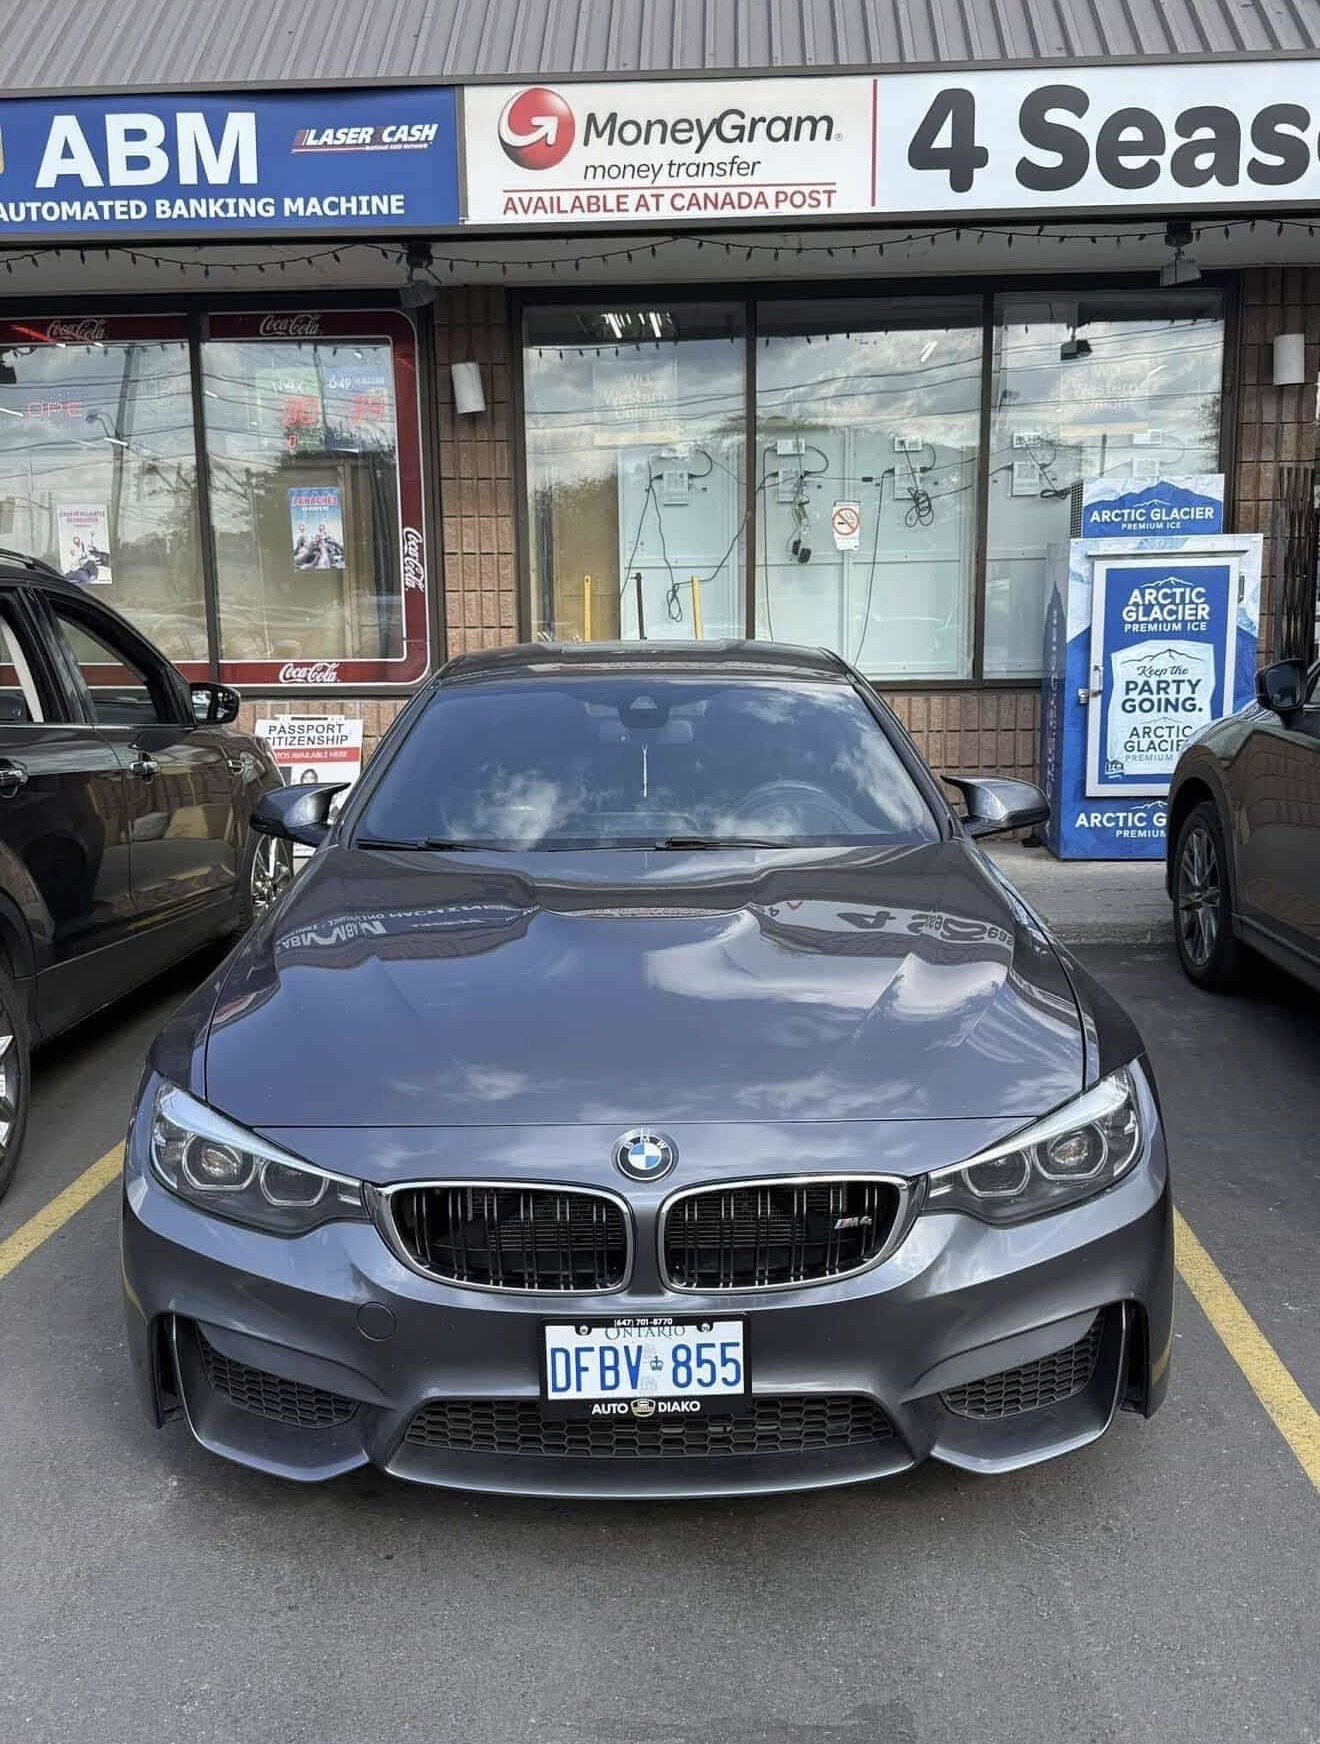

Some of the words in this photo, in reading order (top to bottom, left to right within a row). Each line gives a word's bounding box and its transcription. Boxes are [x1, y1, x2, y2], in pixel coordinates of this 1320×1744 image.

[304, 127, 375, 146] LASER
[381, 123, 439, 143] CASH
[583, 108, 834, 154] MoneyGram
[907, 88, 989, 193] 4
[1014, 84, 1320, 192] Seas
[35, 111, 259, 189] ABM
[583, 160, 664, 185] money
[667, 155, 761, 178] transfer
[155, 197, 276, 219] BANKING
[284, 194, 406, 217] MACHINE
[503, 194, 630, 216] AVAILABLE
[635, 193, 664, 213] AT
[669, 191, 768, 212] CANADA
[774, 188, 838, 210] POST
[47, 318, 106, 341] Coca-Cola
[258, 314, 321, 336] Coca-Cola
[1090, 508, 1146, 523] ARCTIC
[1151, 506, 1214, 521] GLACIER
[1122, 521, 1163, 531] PREMIUM
[1167, 521, 1181, 530] ICE
[403, 527, 425, 592] Coca-Cola
[1128, 587, 1206, 605] ARCTIC
[1122, 603, 1211, 622] GLACIER
[1124, 622, 1182, 633] PREMIUM
[1187, 621, 1208, 632] ICE
[279, 663, 341, 684] Coca-Cola
[1137, 666, 1169, 678] Keep
[1170, 664, 1189, 676] the
[1124, 679, 1202, 696] PARTY
[1121, 697, 1204, 714] GOING.
[268, 723, 345, 735] PASSPORT
[1128, 725, 1193, 739] ARCTIC
[1125, 753, 1174, 762] PREMIUM
[1075, 811, 1148, 828] ARCTIC
[614, 1318, 634, 1327] (647)
[604, 1325, 686, 1341] ONTARIO
[549, 1344, 643, 1393] DFBV
[671, 1341, 742, 1389] 855
[591, 1402, 629, 1416] AUTO
[657, 1400, 701, 1414] DIAKO
